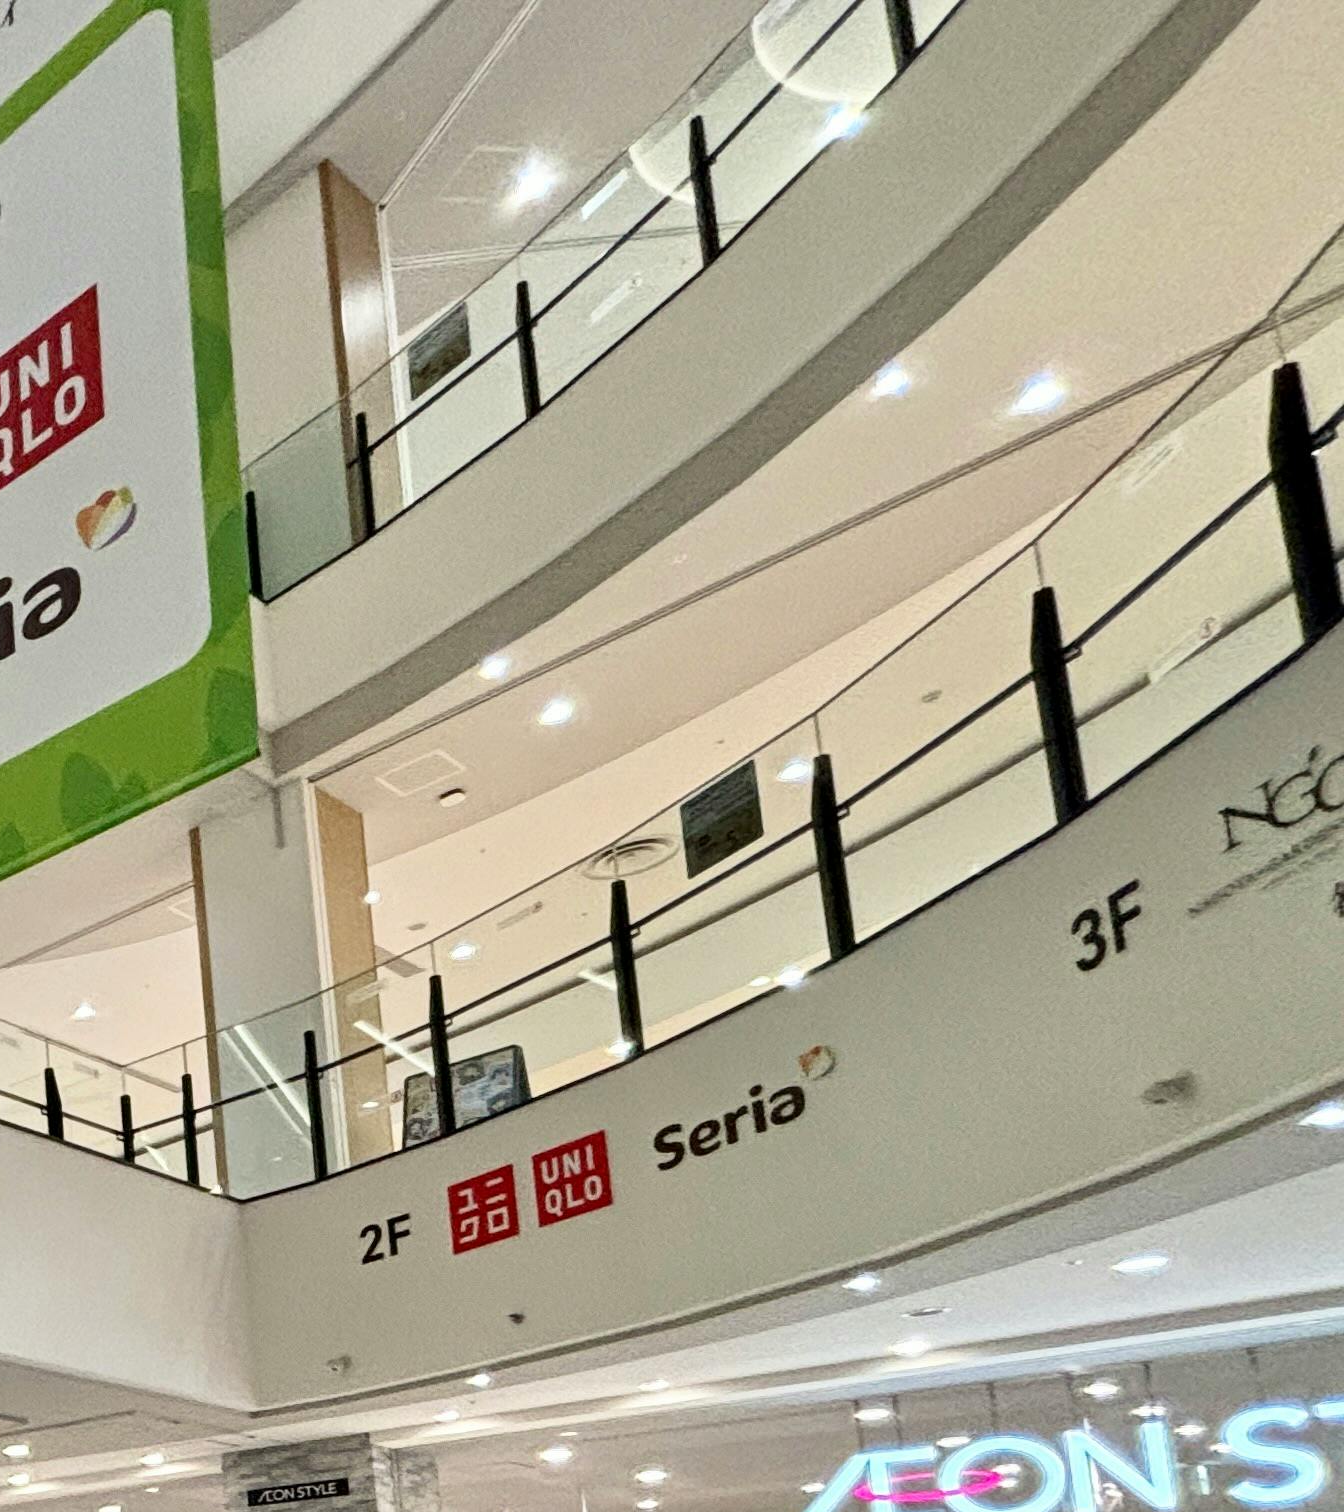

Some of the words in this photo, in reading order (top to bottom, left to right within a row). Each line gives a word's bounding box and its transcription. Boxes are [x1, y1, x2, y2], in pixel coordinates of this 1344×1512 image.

[1071, 878, 1142, 972] 3F
[653, 1082, 807, 1172] Seria
[539, 1142, 596, 1186] UNI
[544, 1173, 605, 1218] QLO
[359, 1212, 412, 1265] 2F
[296, 1481, 338, 1499] STYLE
